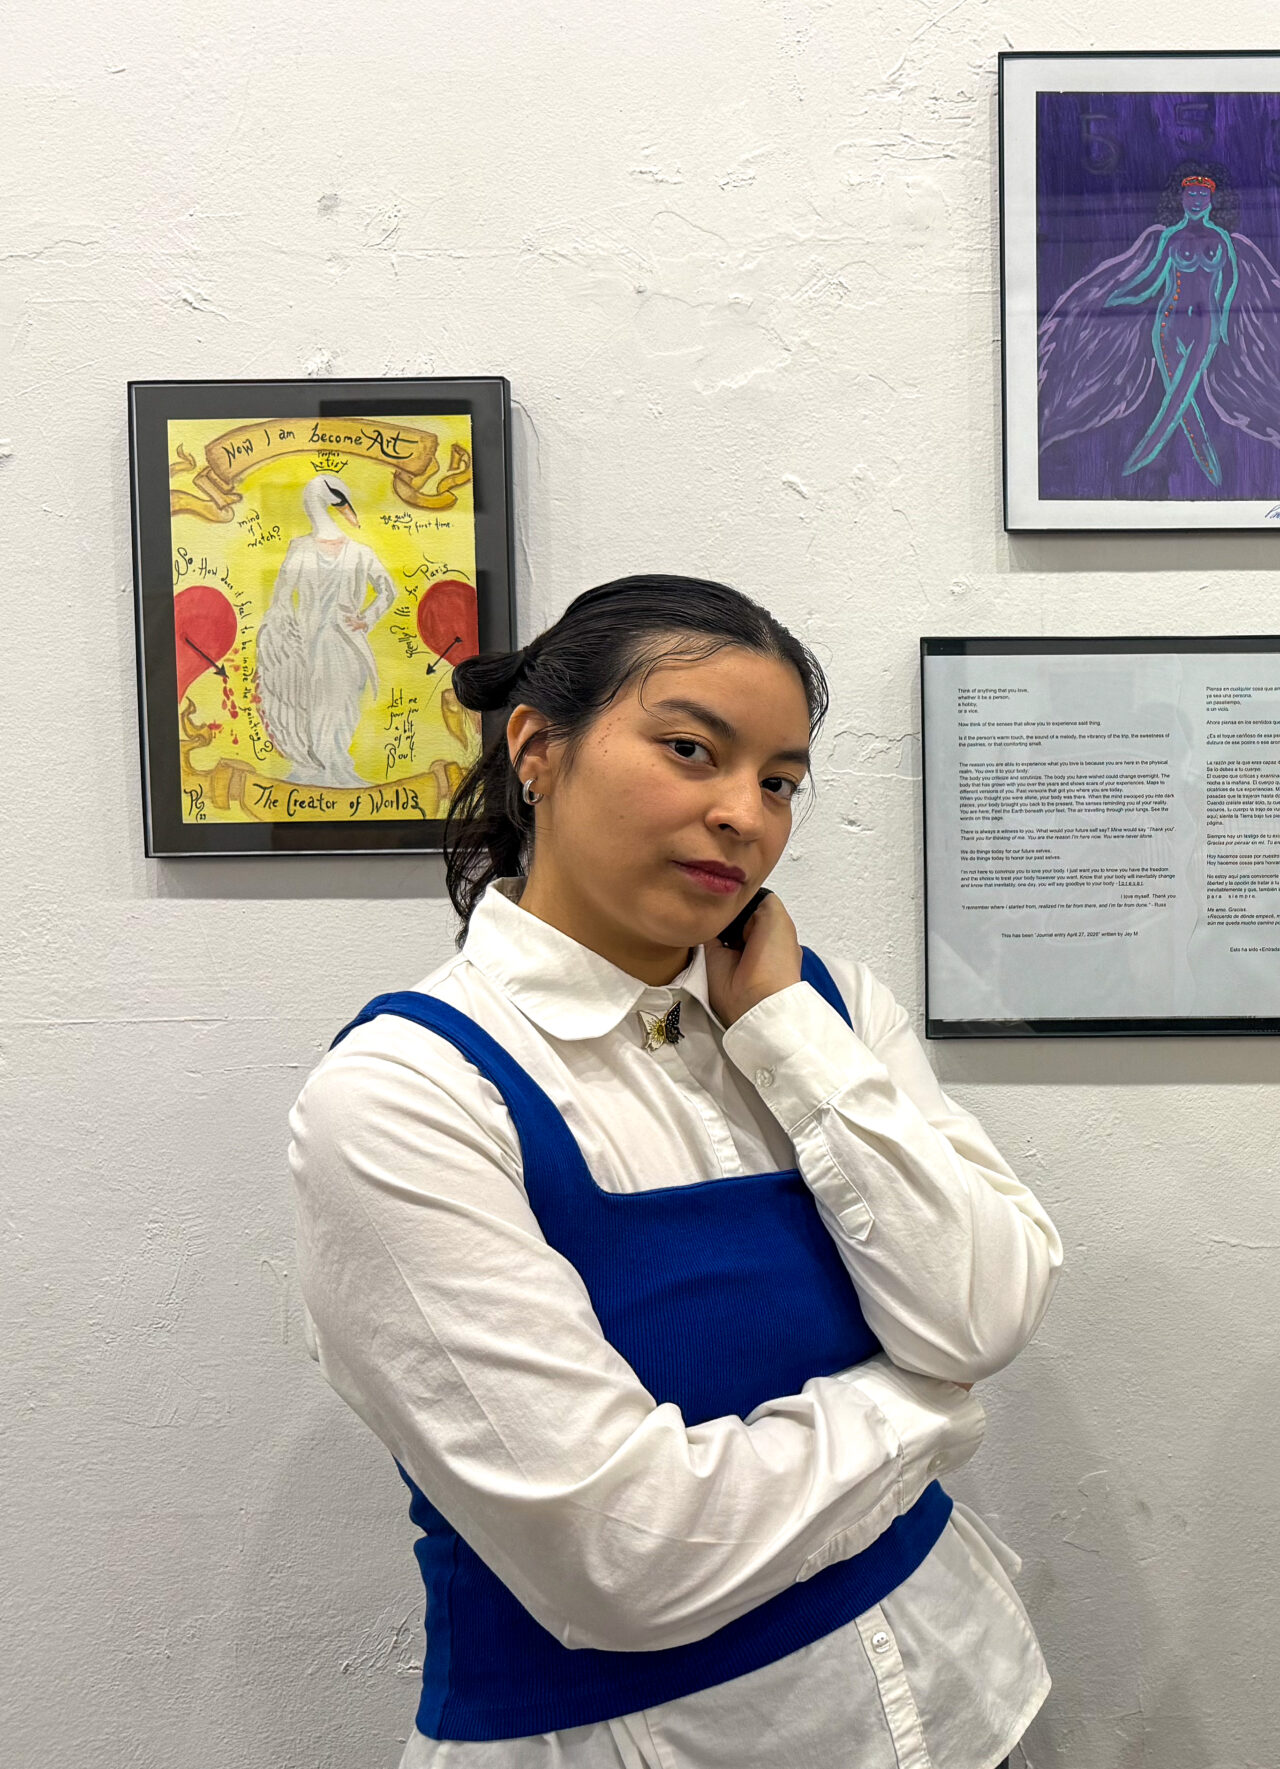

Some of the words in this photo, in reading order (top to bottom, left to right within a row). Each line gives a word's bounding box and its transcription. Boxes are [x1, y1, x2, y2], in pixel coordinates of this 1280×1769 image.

[222, 439, 254, 468] Now
[278, 430, 295, 440] am
[308, 423, 362, 444] become
[361, 428, 418, 459] Art
[237, 509, 260, 527] mind
[241, 640, 252, 651] be
[242, 657, 254, 682] inside
[252, 783, 279, 809] The
[287, 788, 338, 817] Creator
[349, 795, 361, 817] of
[370, 787, 426, 820] Worlds
